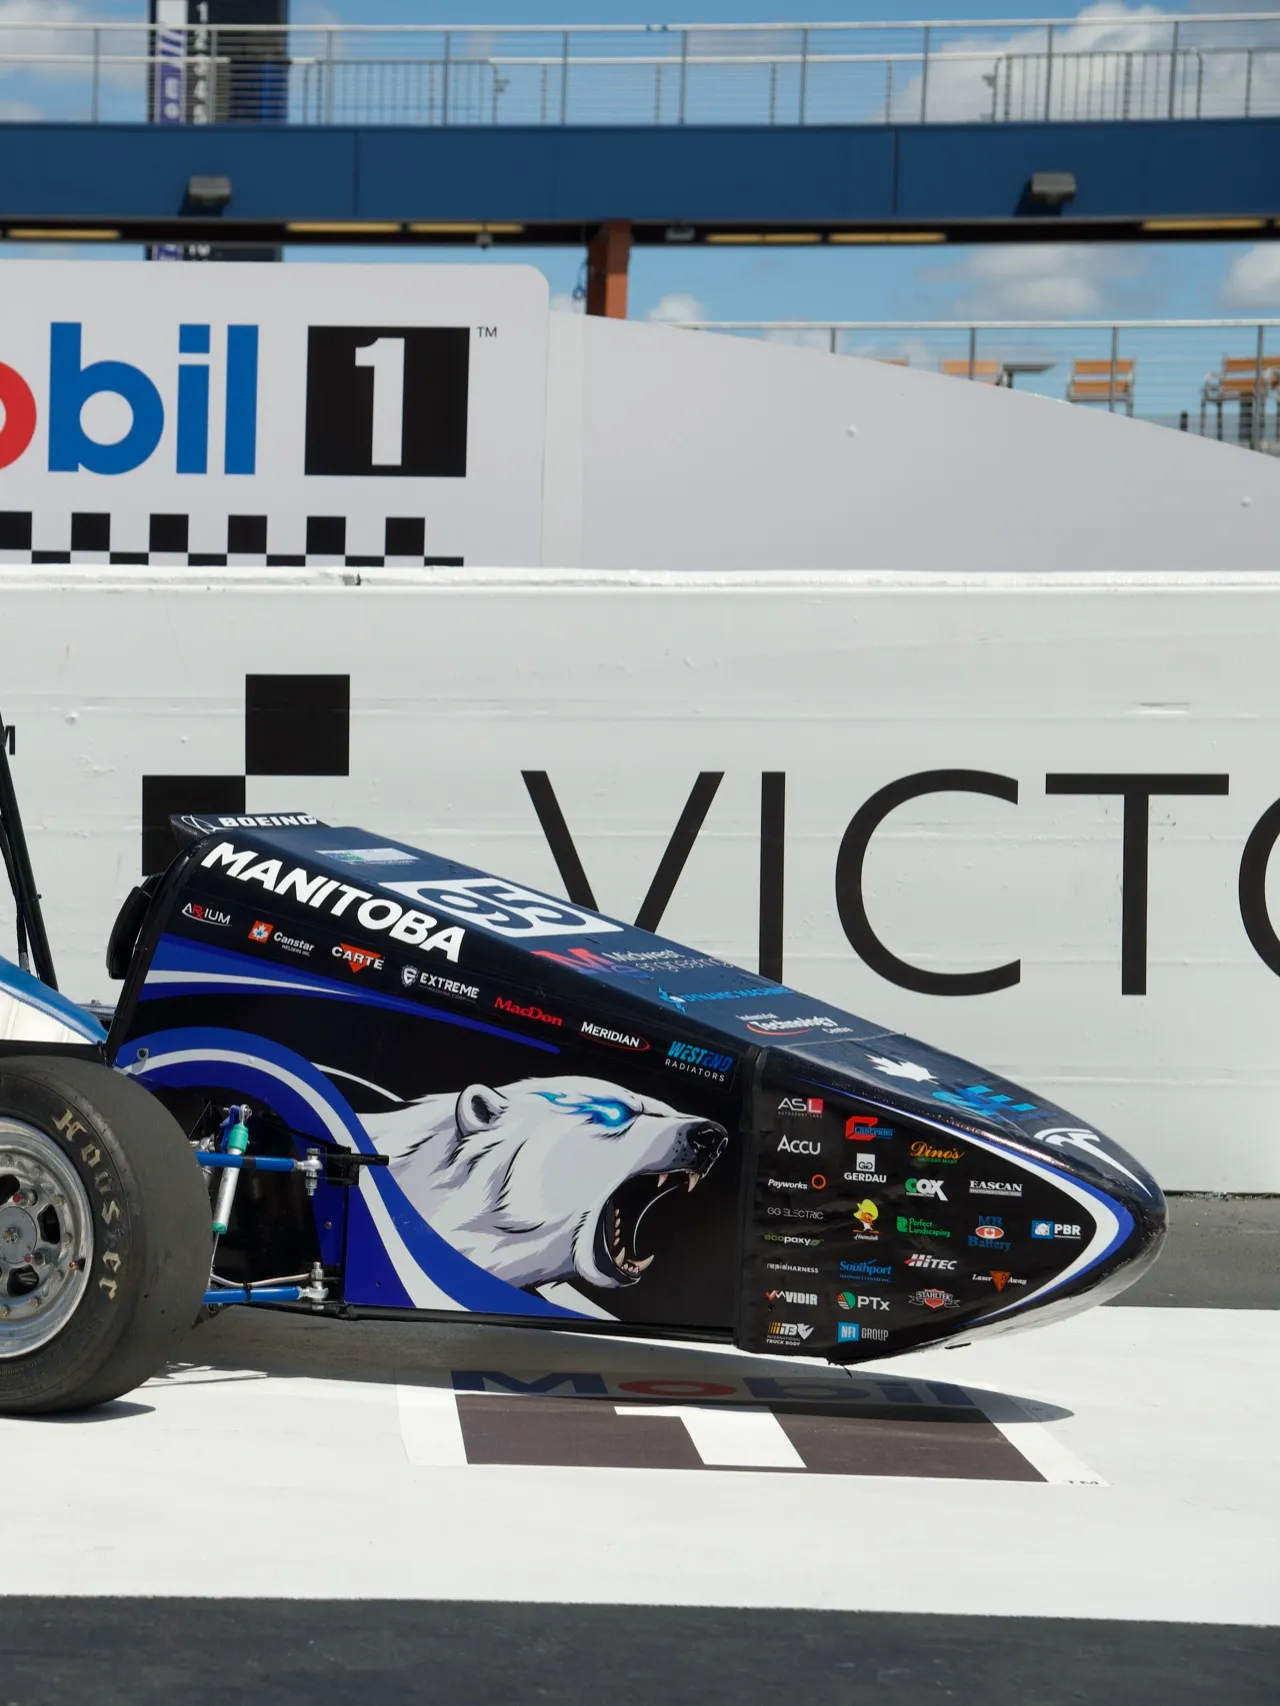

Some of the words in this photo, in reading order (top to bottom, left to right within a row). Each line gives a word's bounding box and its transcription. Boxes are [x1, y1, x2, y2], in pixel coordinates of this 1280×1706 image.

[354, 336, 406, 468] 1
[217, 815, 319, 828] BOEING
[199, 841, 466, 963] MANITOBA
[416, 885, 588, 930] 95
[273, 931, 315, 952] Canstar
[331, 945, 385, 971] CARTE
[419, 972, 480, 1000] EXTREME
[494, 997, 563, 1027] MacDon
[581, 1022, 640, 1048] MERIDIAN
[665, 1058, 726, 1082] RADIATORS
[777, 1097, 823, 1114] ASL
[777, 1135, 821, 1155] ACCU
[911, 1141, 966, 1160] Dino's
[767, 1179, 808, 1190] Payworks
[844, 1172, 888, 1183] GERDAU
[969, 1180, 1024, 1192] EASCAN
[905, 1178, 949, 1201] COX
[783, 1208, 824, 1220] ELECTRIC
[909, 1218, 934, 1228] Perfect
[1053, 1223, 1082, 1236] PBR
[764, 1234, 811, 1246] ecopoxy
[908, 1226, 952, 1238] Landscaping
[967, 1235, 1012, 1252] Battery
[839, 1259, 892, 1276] Southport
[972, 1273, 993, 1282] Laser
[1007, 1276, 1028, 1286] Away
[785, 1292, 818, 1306] VIDIR
[857, 1295, 891, 1311] PTx
[840, 1325, 857, 1339] NFI
[861, 1328, 889, 1341] GROUP
[450, 1370, 975, 1406] Mobil
